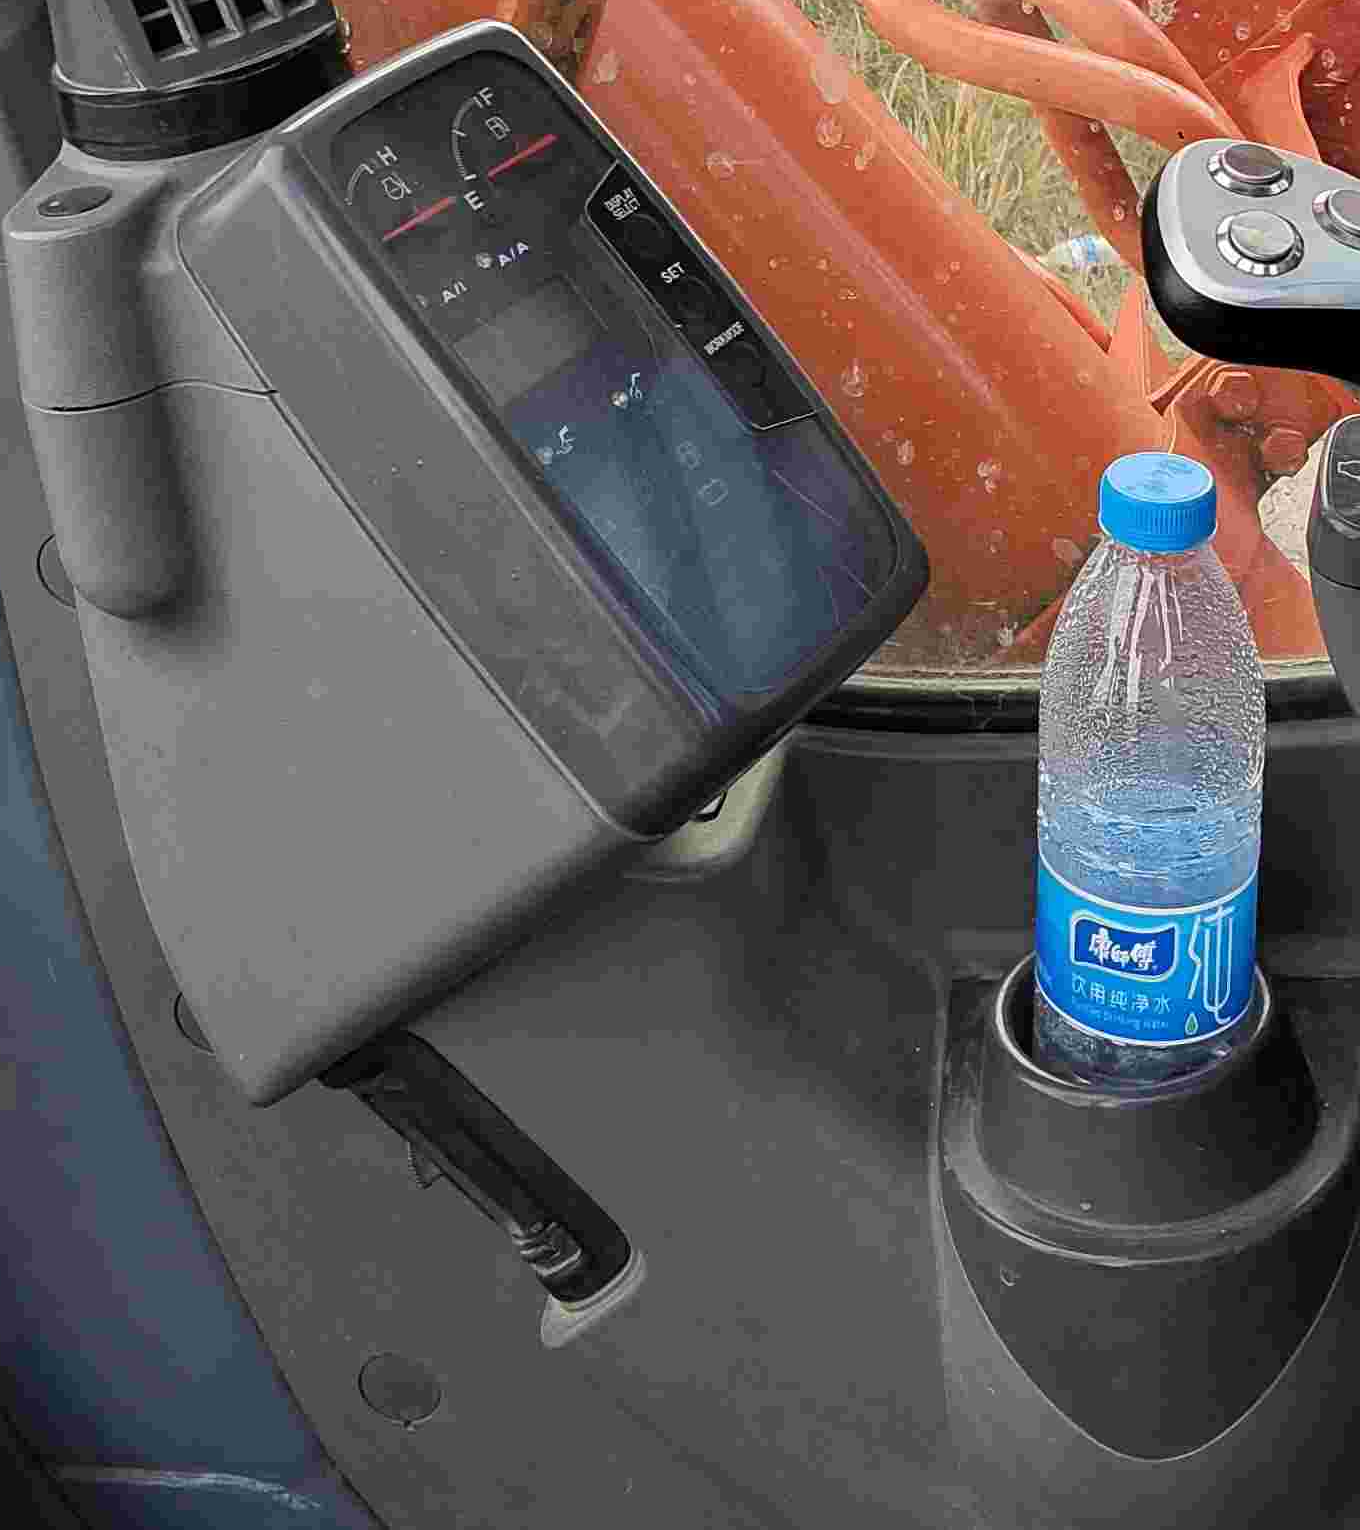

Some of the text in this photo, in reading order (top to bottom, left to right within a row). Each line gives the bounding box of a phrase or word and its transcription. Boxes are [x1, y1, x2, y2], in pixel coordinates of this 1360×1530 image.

[376, 145, 398, 166] H
[464, 190, 484, 211] E
[660, 261, 686, 284] SET
